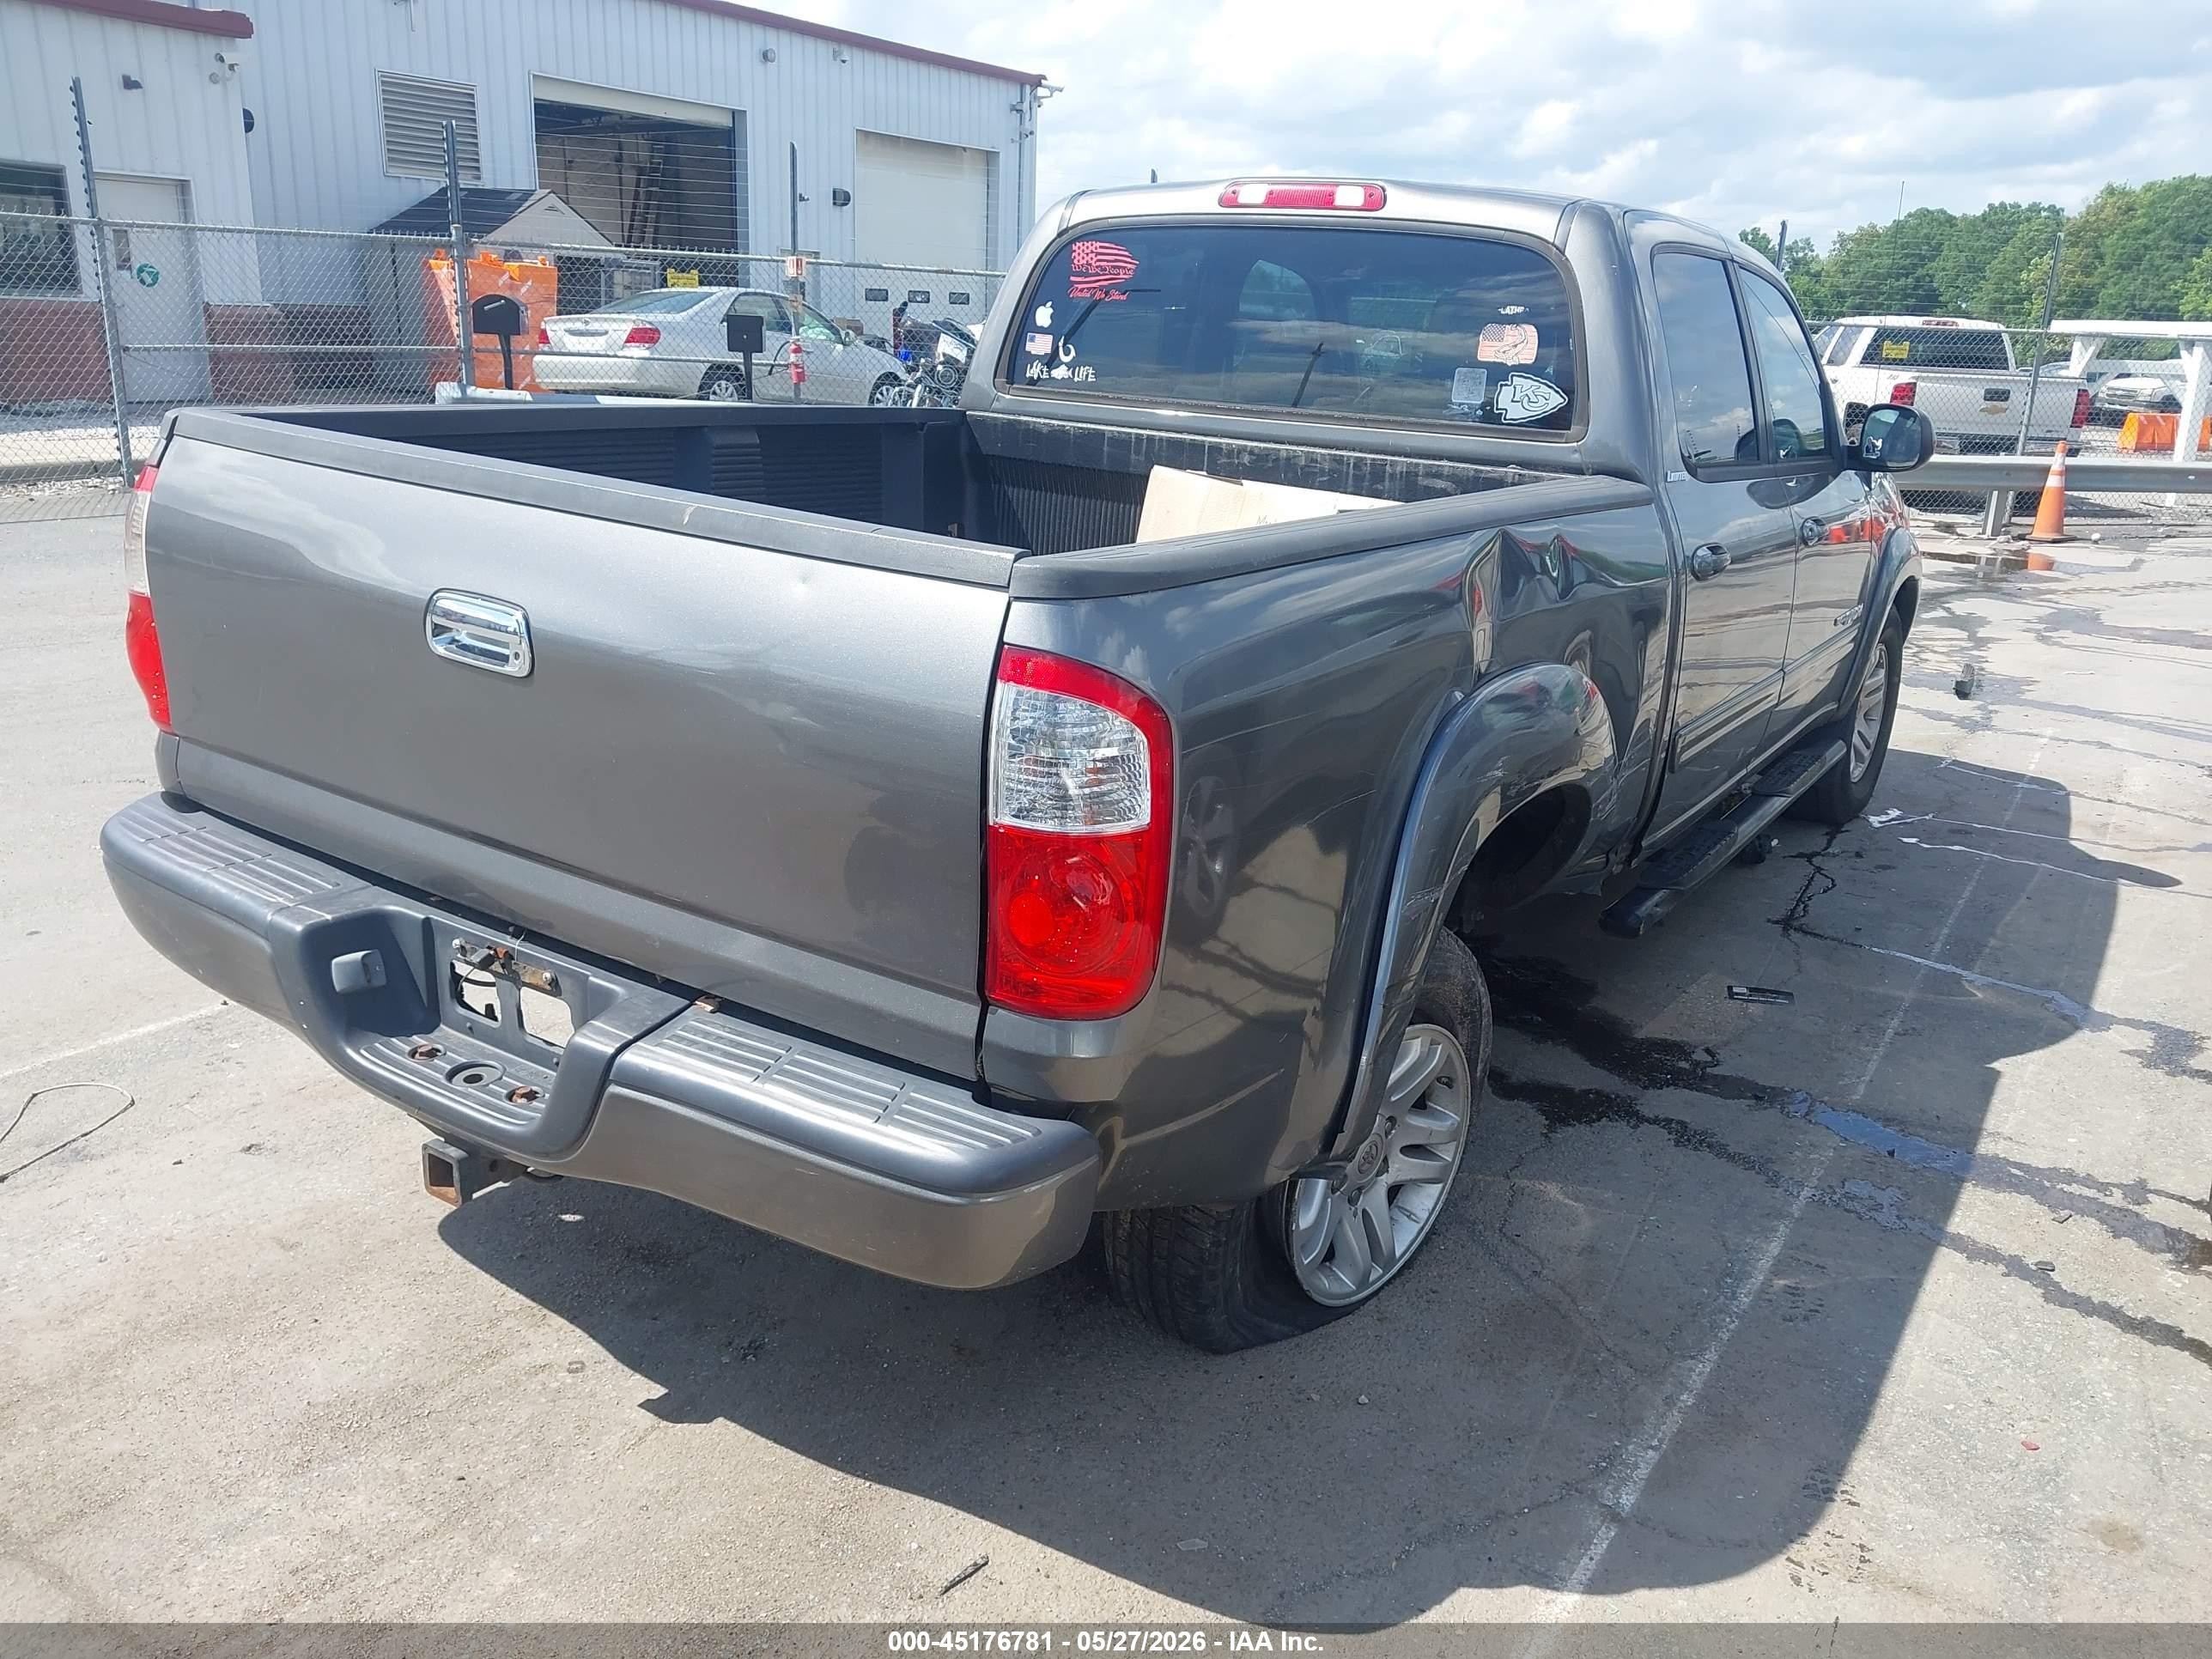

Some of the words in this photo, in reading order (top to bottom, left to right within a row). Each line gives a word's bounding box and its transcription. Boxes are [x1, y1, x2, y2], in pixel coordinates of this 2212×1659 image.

[1099, 264, 1135, 276] People
[1067, 286, 1093, 298] United
[1104, 289, 1129, 301] Stand
[1026, 360, 1049, 380] LAKE
[1073, 365, 1097, 382] LIFE
[1511, 384, 1552, 412] KC
